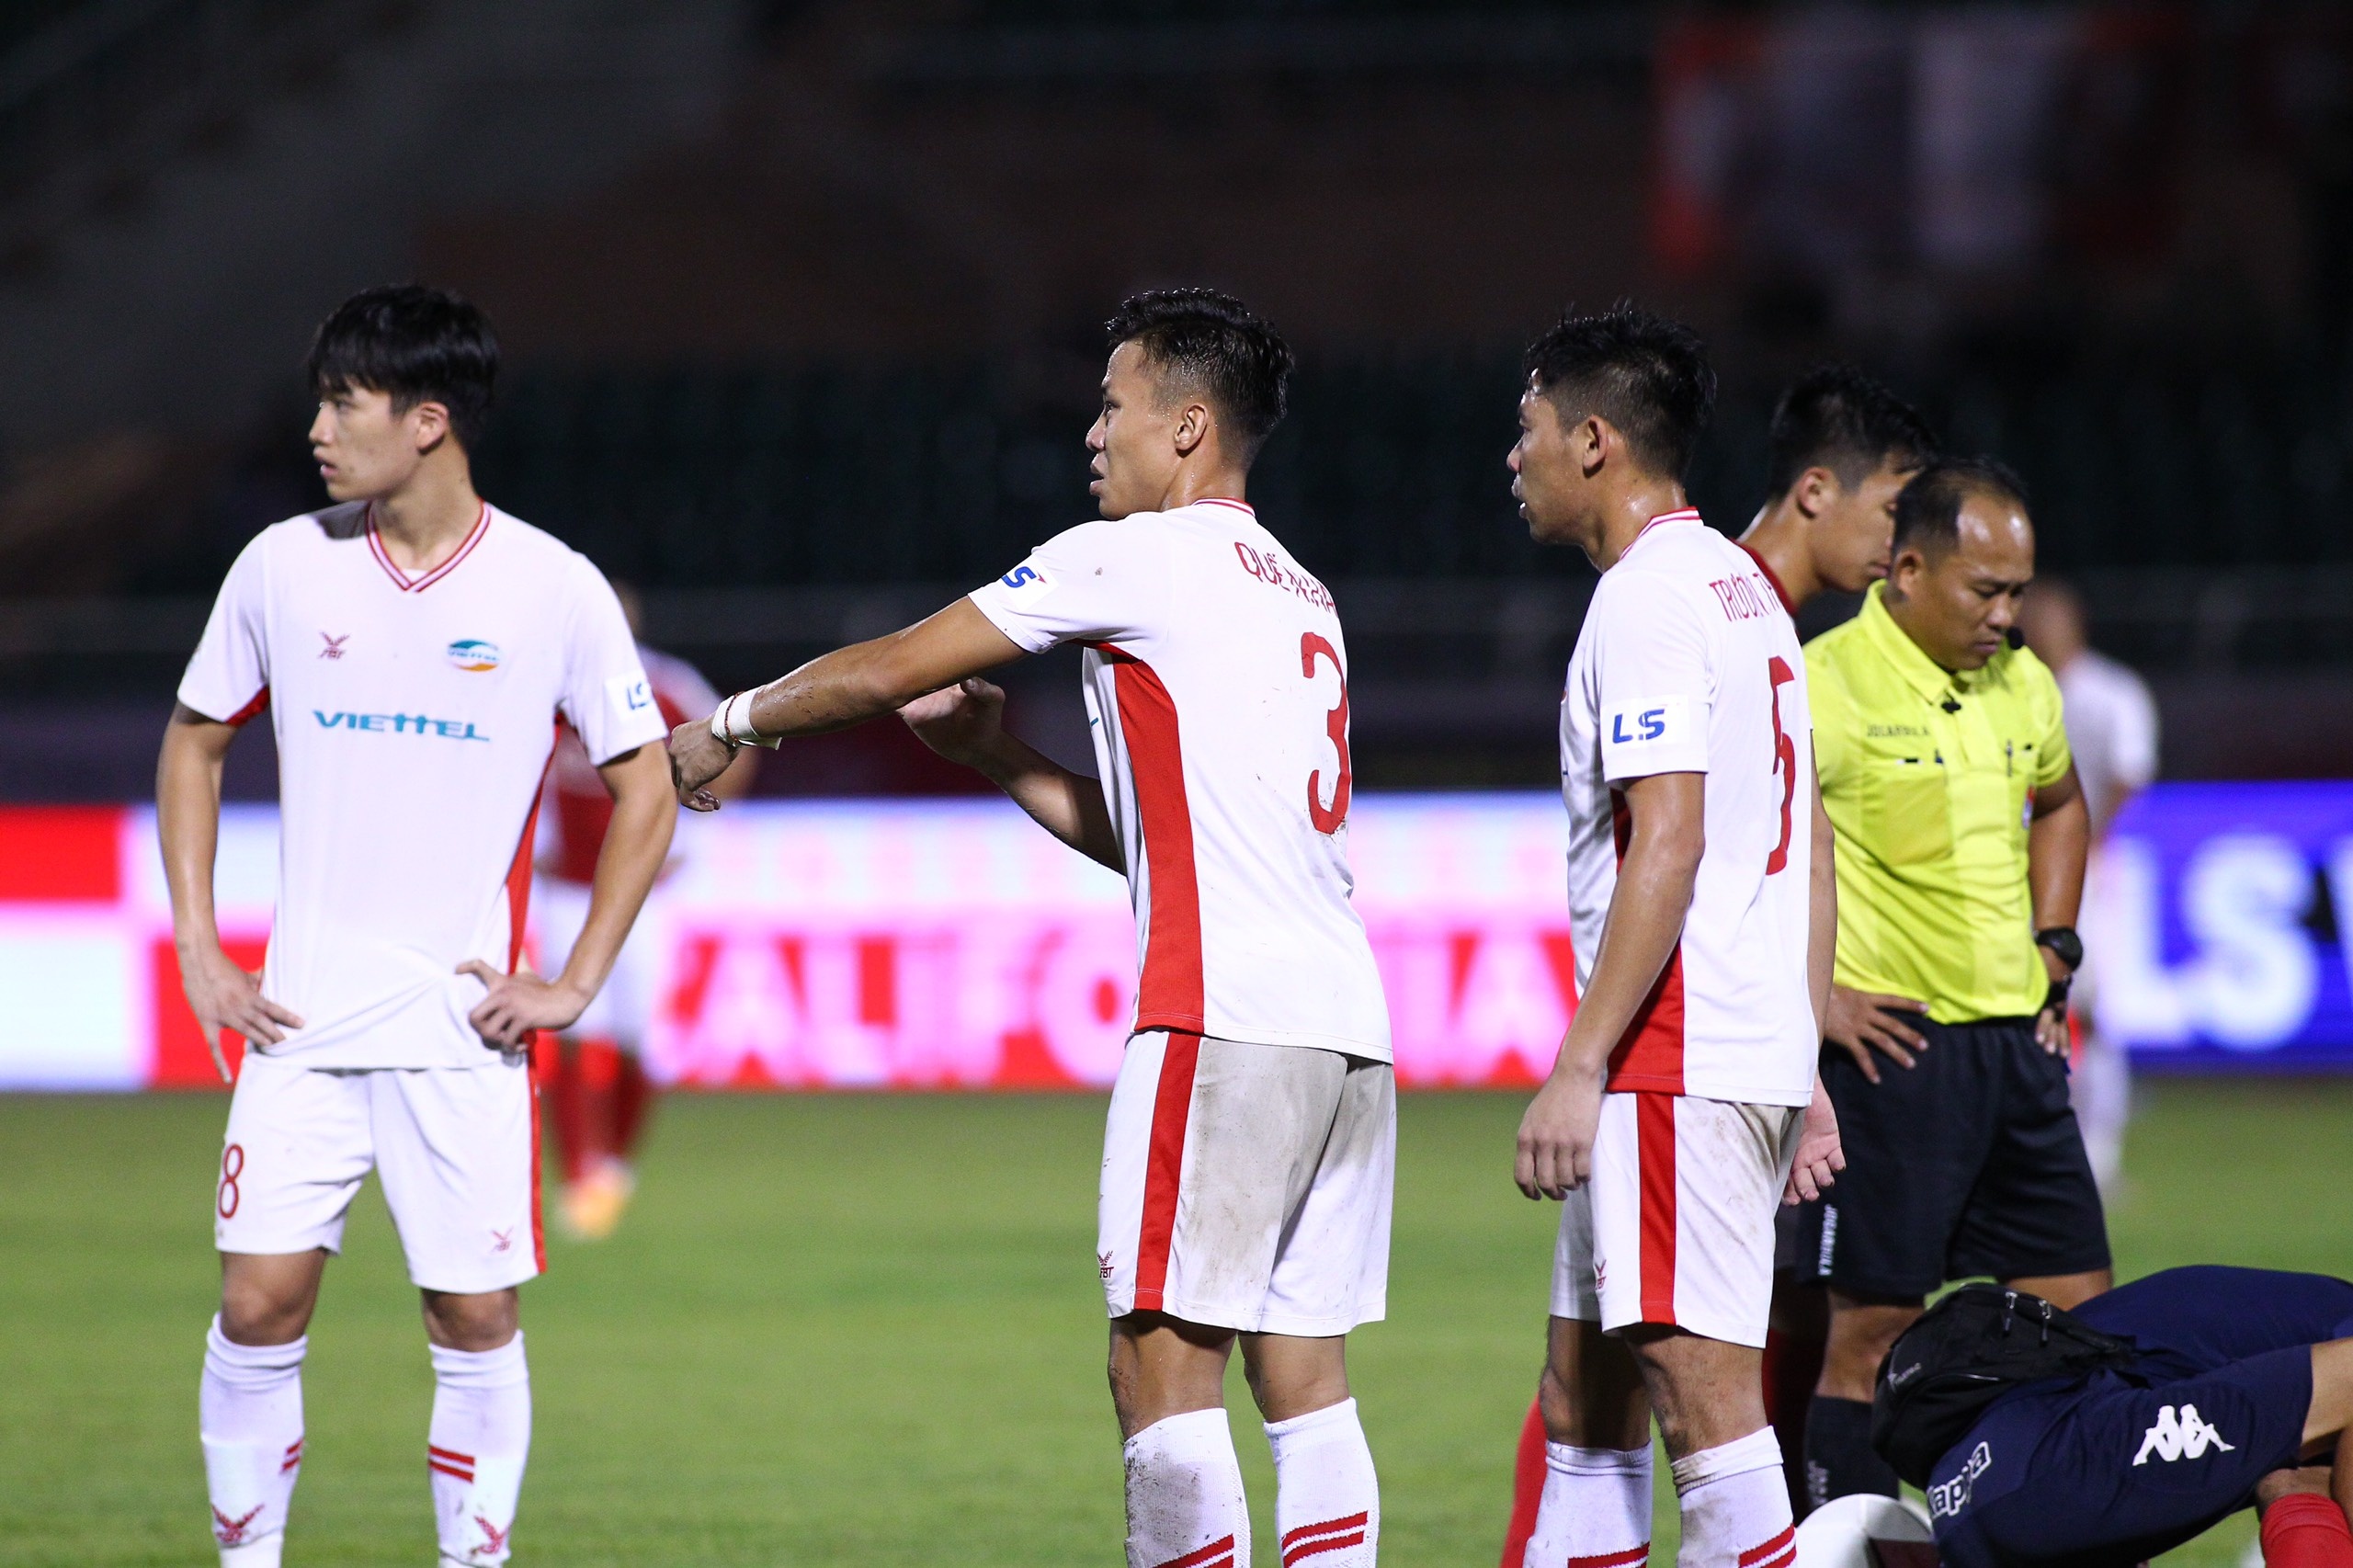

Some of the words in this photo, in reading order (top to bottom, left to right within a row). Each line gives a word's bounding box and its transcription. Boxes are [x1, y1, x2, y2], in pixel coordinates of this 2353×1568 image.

[1001, 566, 1037, 588] S
[1301, 632, 1351, 835] 3
[2096, 829, 2320, 1052] LS
[217, 1143, 244, 1219] 8
[1927, 1440, 1992, 1518] appa
